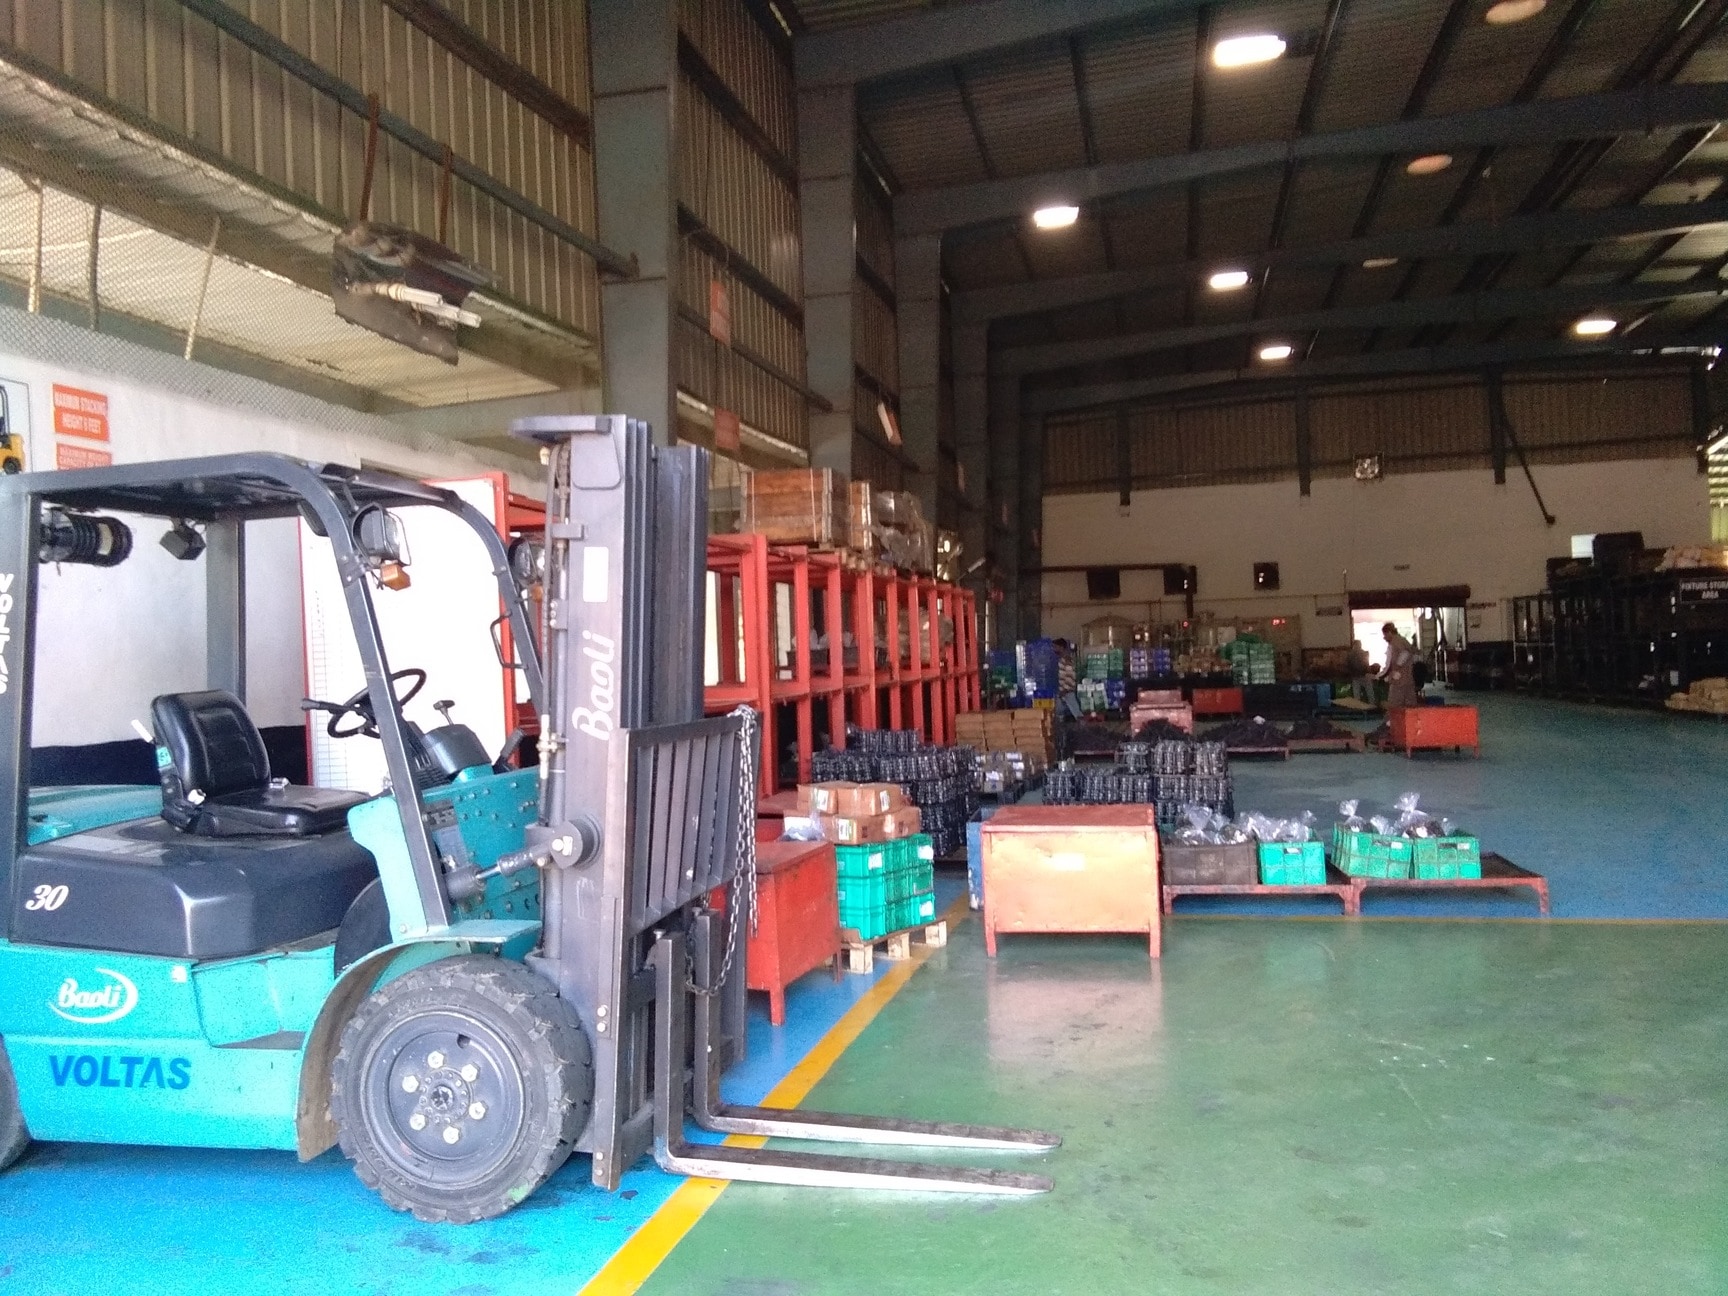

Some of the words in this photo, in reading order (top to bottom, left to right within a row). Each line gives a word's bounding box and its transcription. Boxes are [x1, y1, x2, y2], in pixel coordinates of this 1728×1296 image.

[571, 630, 615, 741] Baoli
[25, 884, 69, 911] 30
[58, 977, 122, 1008] Baoli
[50, 1054, 192, 1090] VOLTAS
